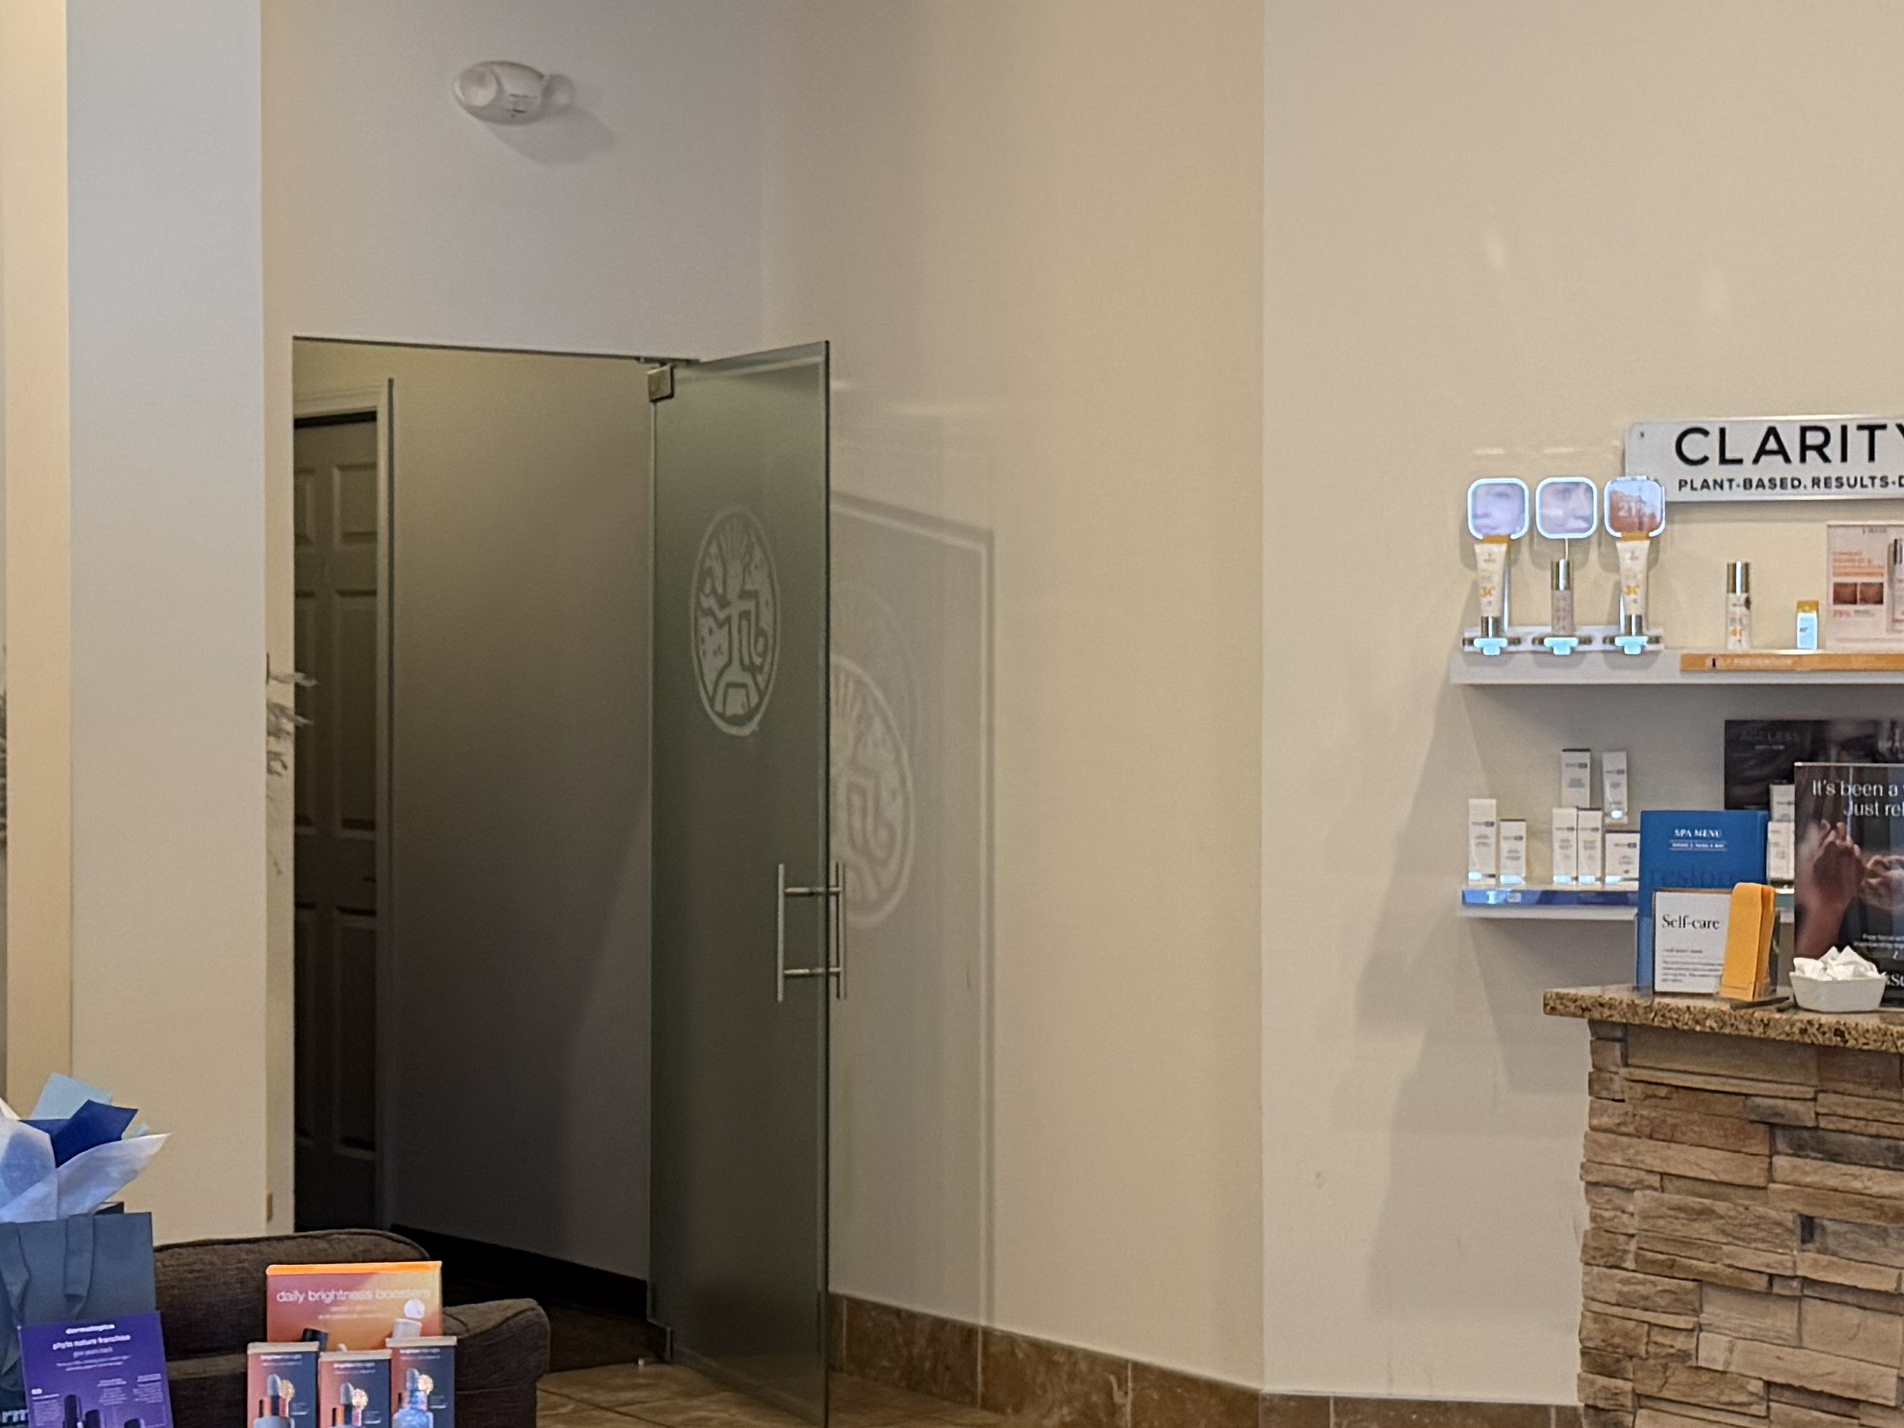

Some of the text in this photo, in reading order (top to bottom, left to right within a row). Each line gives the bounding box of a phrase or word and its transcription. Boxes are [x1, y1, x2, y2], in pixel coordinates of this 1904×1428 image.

[1812, 779, 1836, 797] It's
[1841, 780, 1884, 798] been
[1888, 785, 1899, 798] a
[1843, 800, 1880, 817] Just
[1674, 828, 1722, 838] SPA MENU
[1662, 913, 1721, 930] Self-care
[276, 1287, 432, 1303] daily brightness boosters
